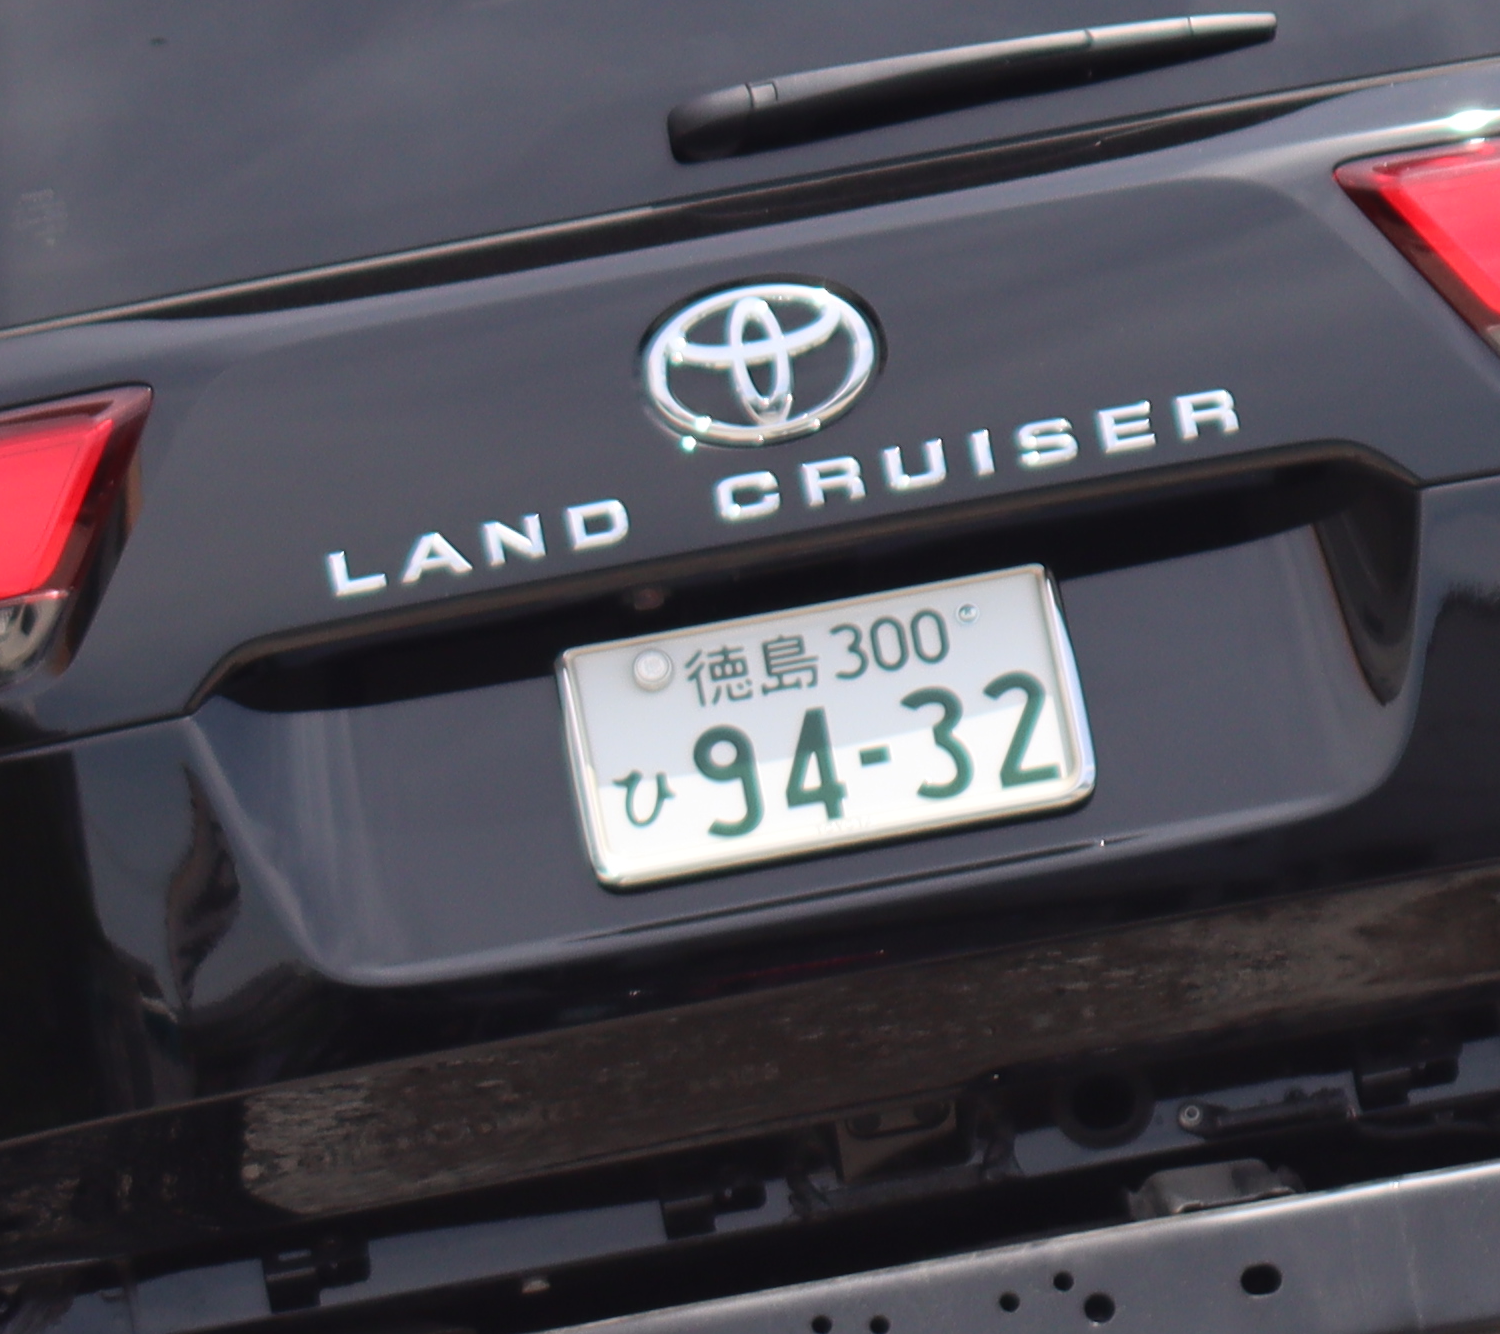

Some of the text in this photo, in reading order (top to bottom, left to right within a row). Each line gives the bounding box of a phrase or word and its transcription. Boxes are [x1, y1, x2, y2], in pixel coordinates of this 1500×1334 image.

[328, 388, 1240, 596] LAND CRUISER
[693, 671, 1063, 837] 94-32
